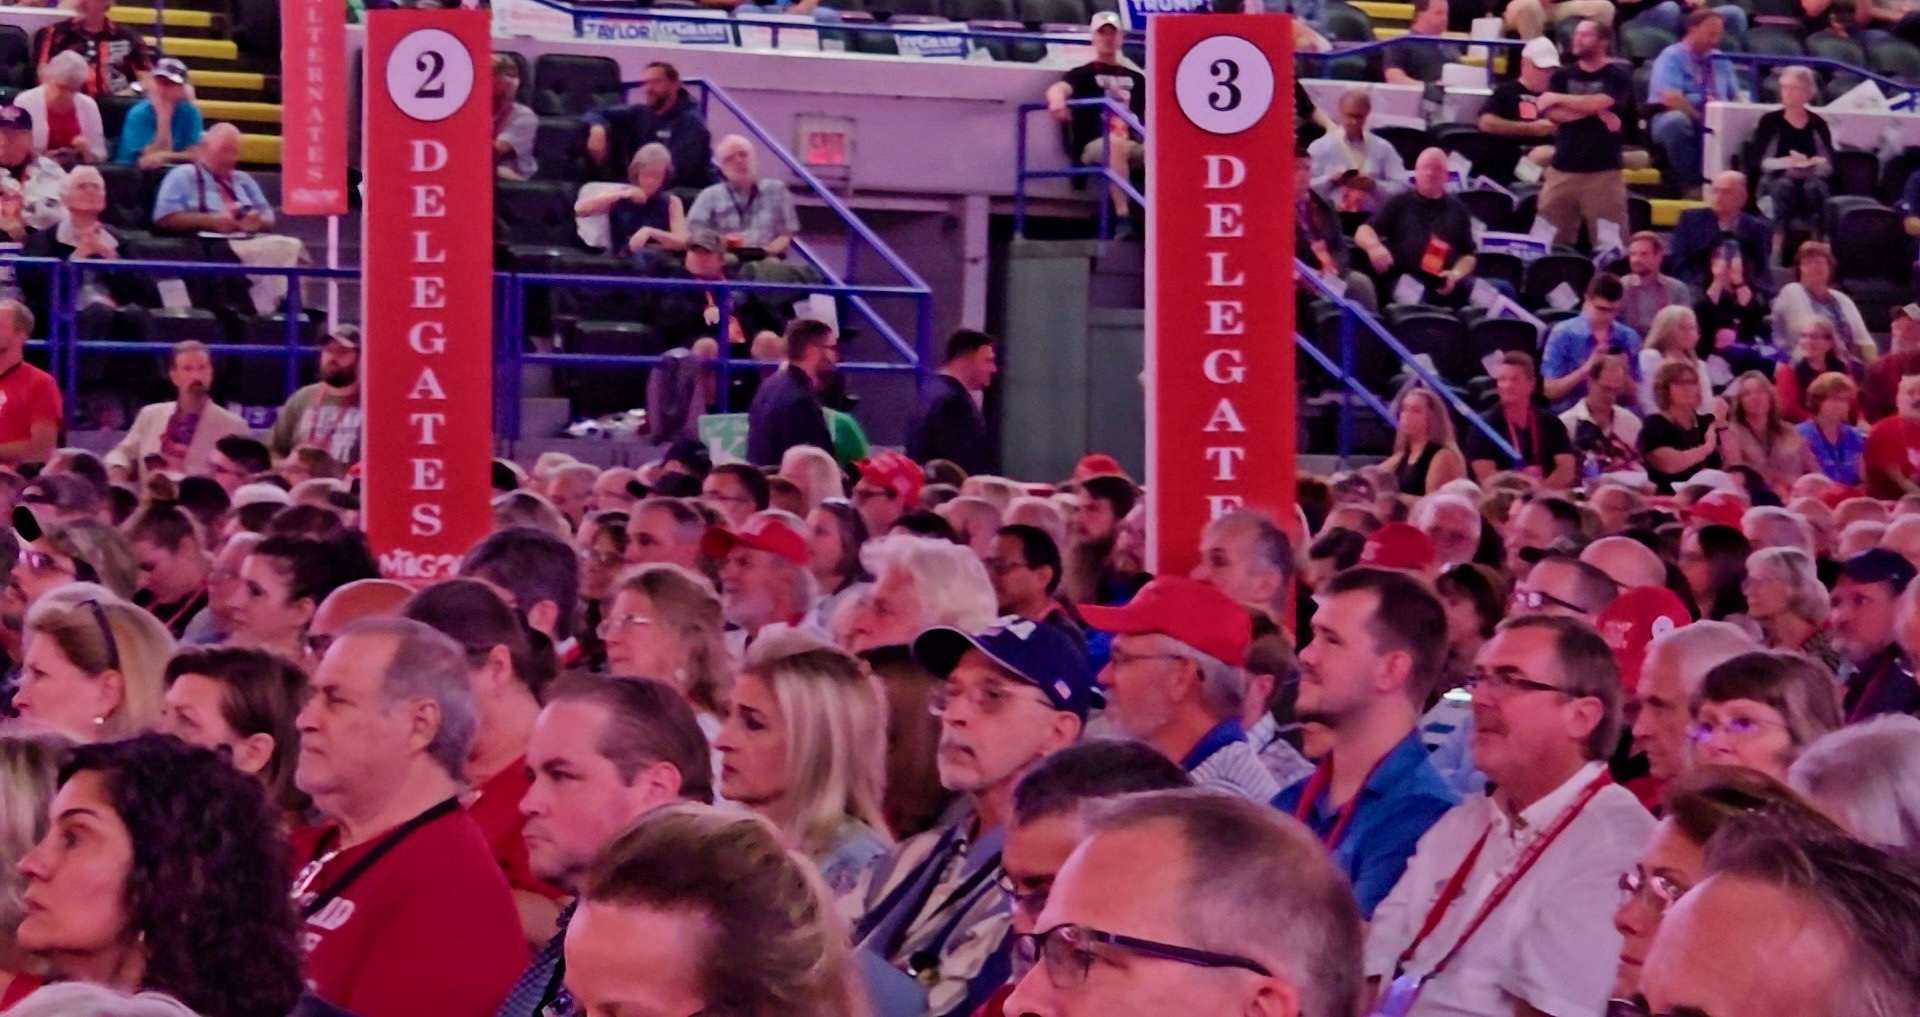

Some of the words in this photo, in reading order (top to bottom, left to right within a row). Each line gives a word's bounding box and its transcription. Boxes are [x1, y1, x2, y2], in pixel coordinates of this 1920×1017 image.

[306, 0, 325, 182] LTERNATES
[414, 50, 446, 98] 2
[1208, 58, 1242, 112] 3
[408, 139, 449, 536] DELEGATES
